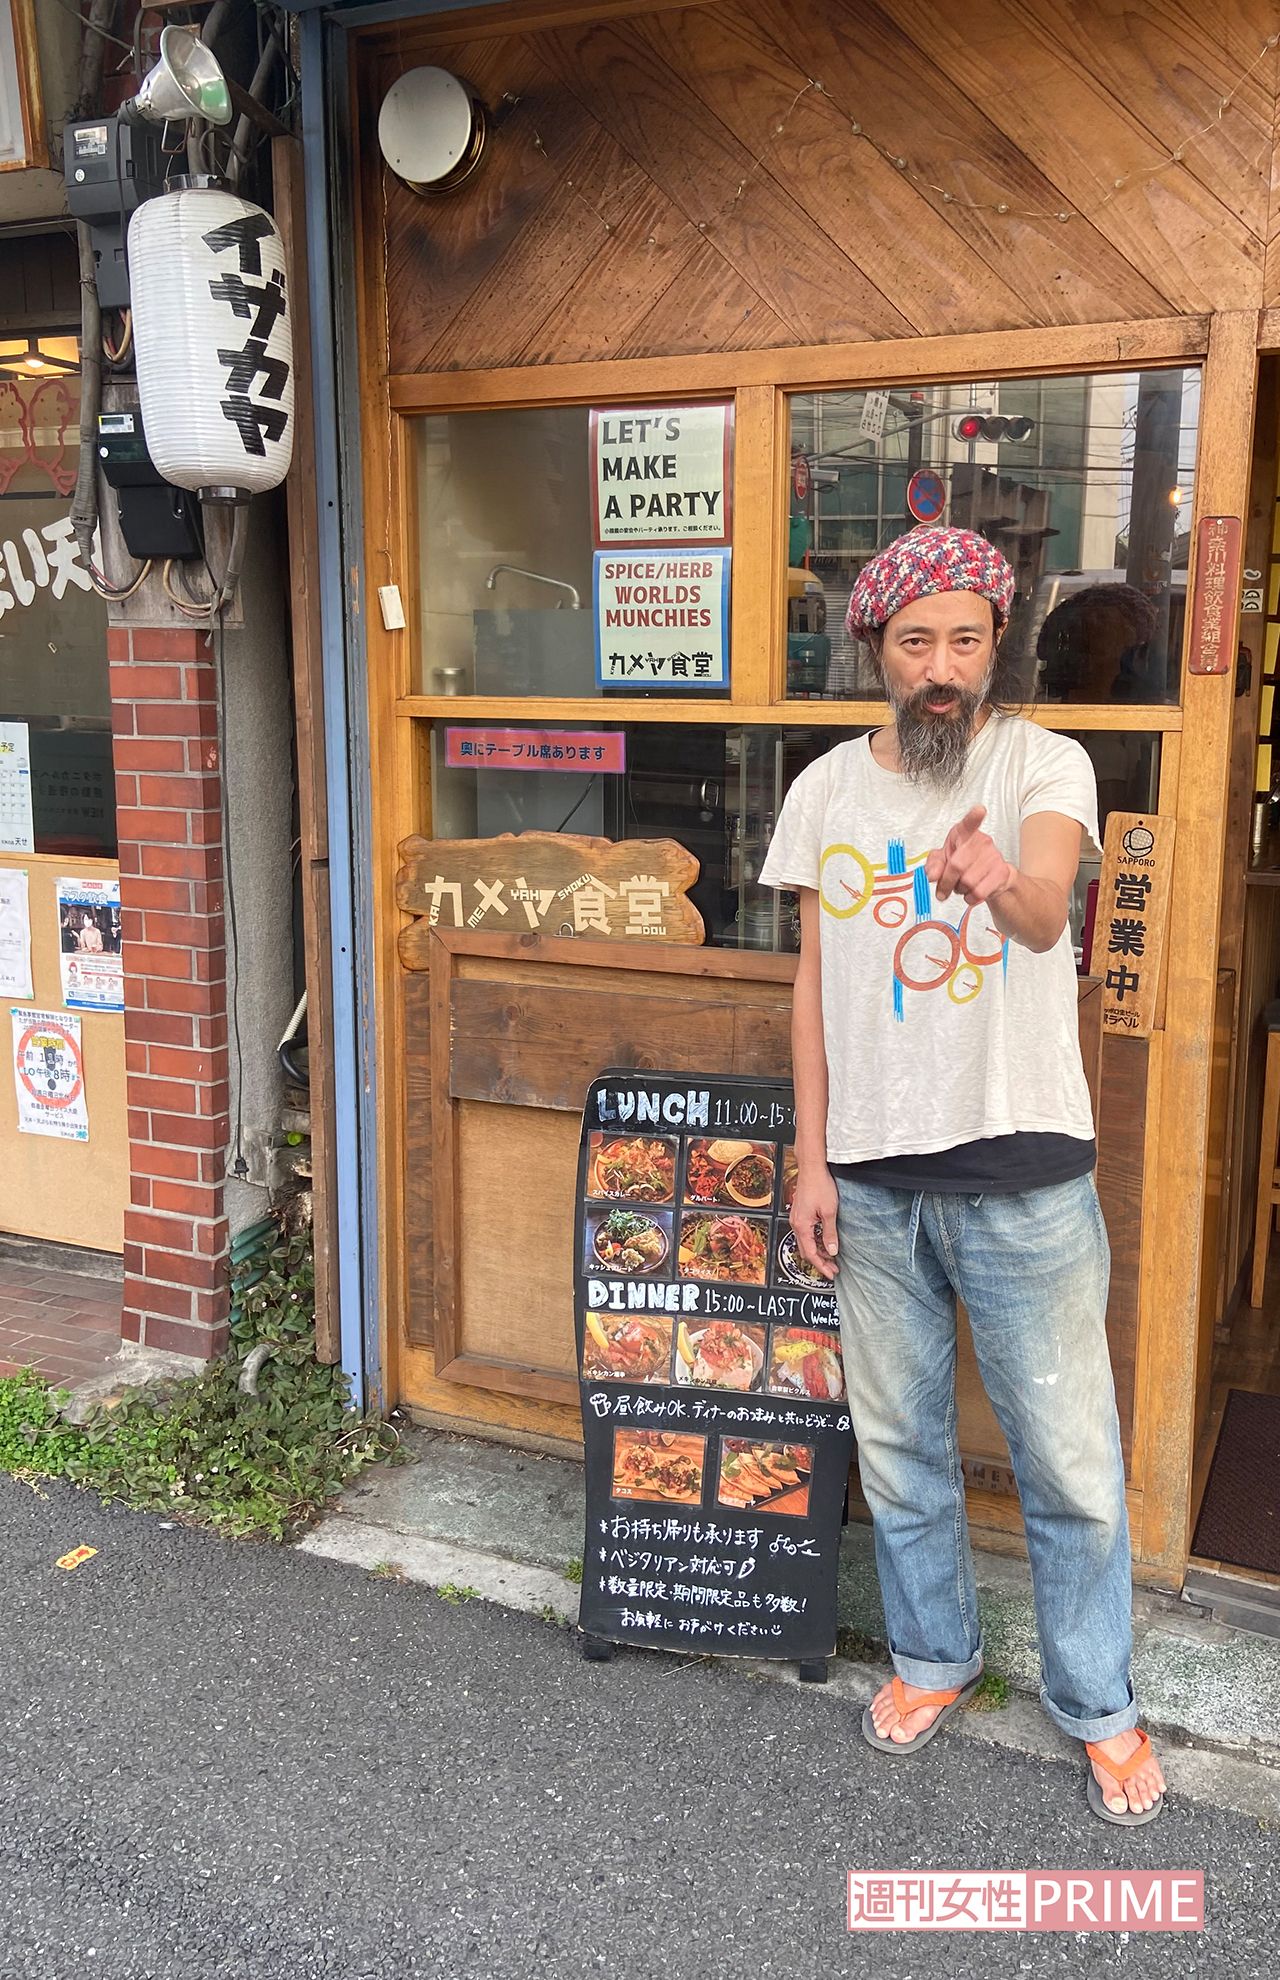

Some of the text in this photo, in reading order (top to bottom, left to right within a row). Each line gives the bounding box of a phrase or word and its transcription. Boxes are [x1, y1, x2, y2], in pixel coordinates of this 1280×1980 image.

[201, 213, 289, 457] イザカヤ
[603, 416, 681, 445] LET'S
[602, 454, 677, 482] MAKE
[603, 489, 721, 520] A PARTY
[605, 562, 713, 579] SPICE/HERB
[615, 585, 701, 604] WORLDS
[606, 609, 711, 627] MUNCHIES
[608, 651, 713, 677] カメヤ食堂
[460, 741, 606, 760] 奥にテーブル席あります
[1117, 856, 1156, 868] SAPPORO
[557, 873, 593, 901] SHOKU
[424, 874, 670, 936] カメヤ食堂
[1105, 872, 1152, 1001] 営業中
[597, 1088, 711, 1127] LUNCH
[592, 1189, 631, 1199] スパイスカレー
[588, 1280, 700, 1312] DINNER
[811, 1311, 840, 1326] Weeke
[615, 1487, 632, 1495] タコス
[610, 1515, 764, 1550] お持ち帰りも承ります
[610, 1549, 737, 1577] ベジタリアン対応可
